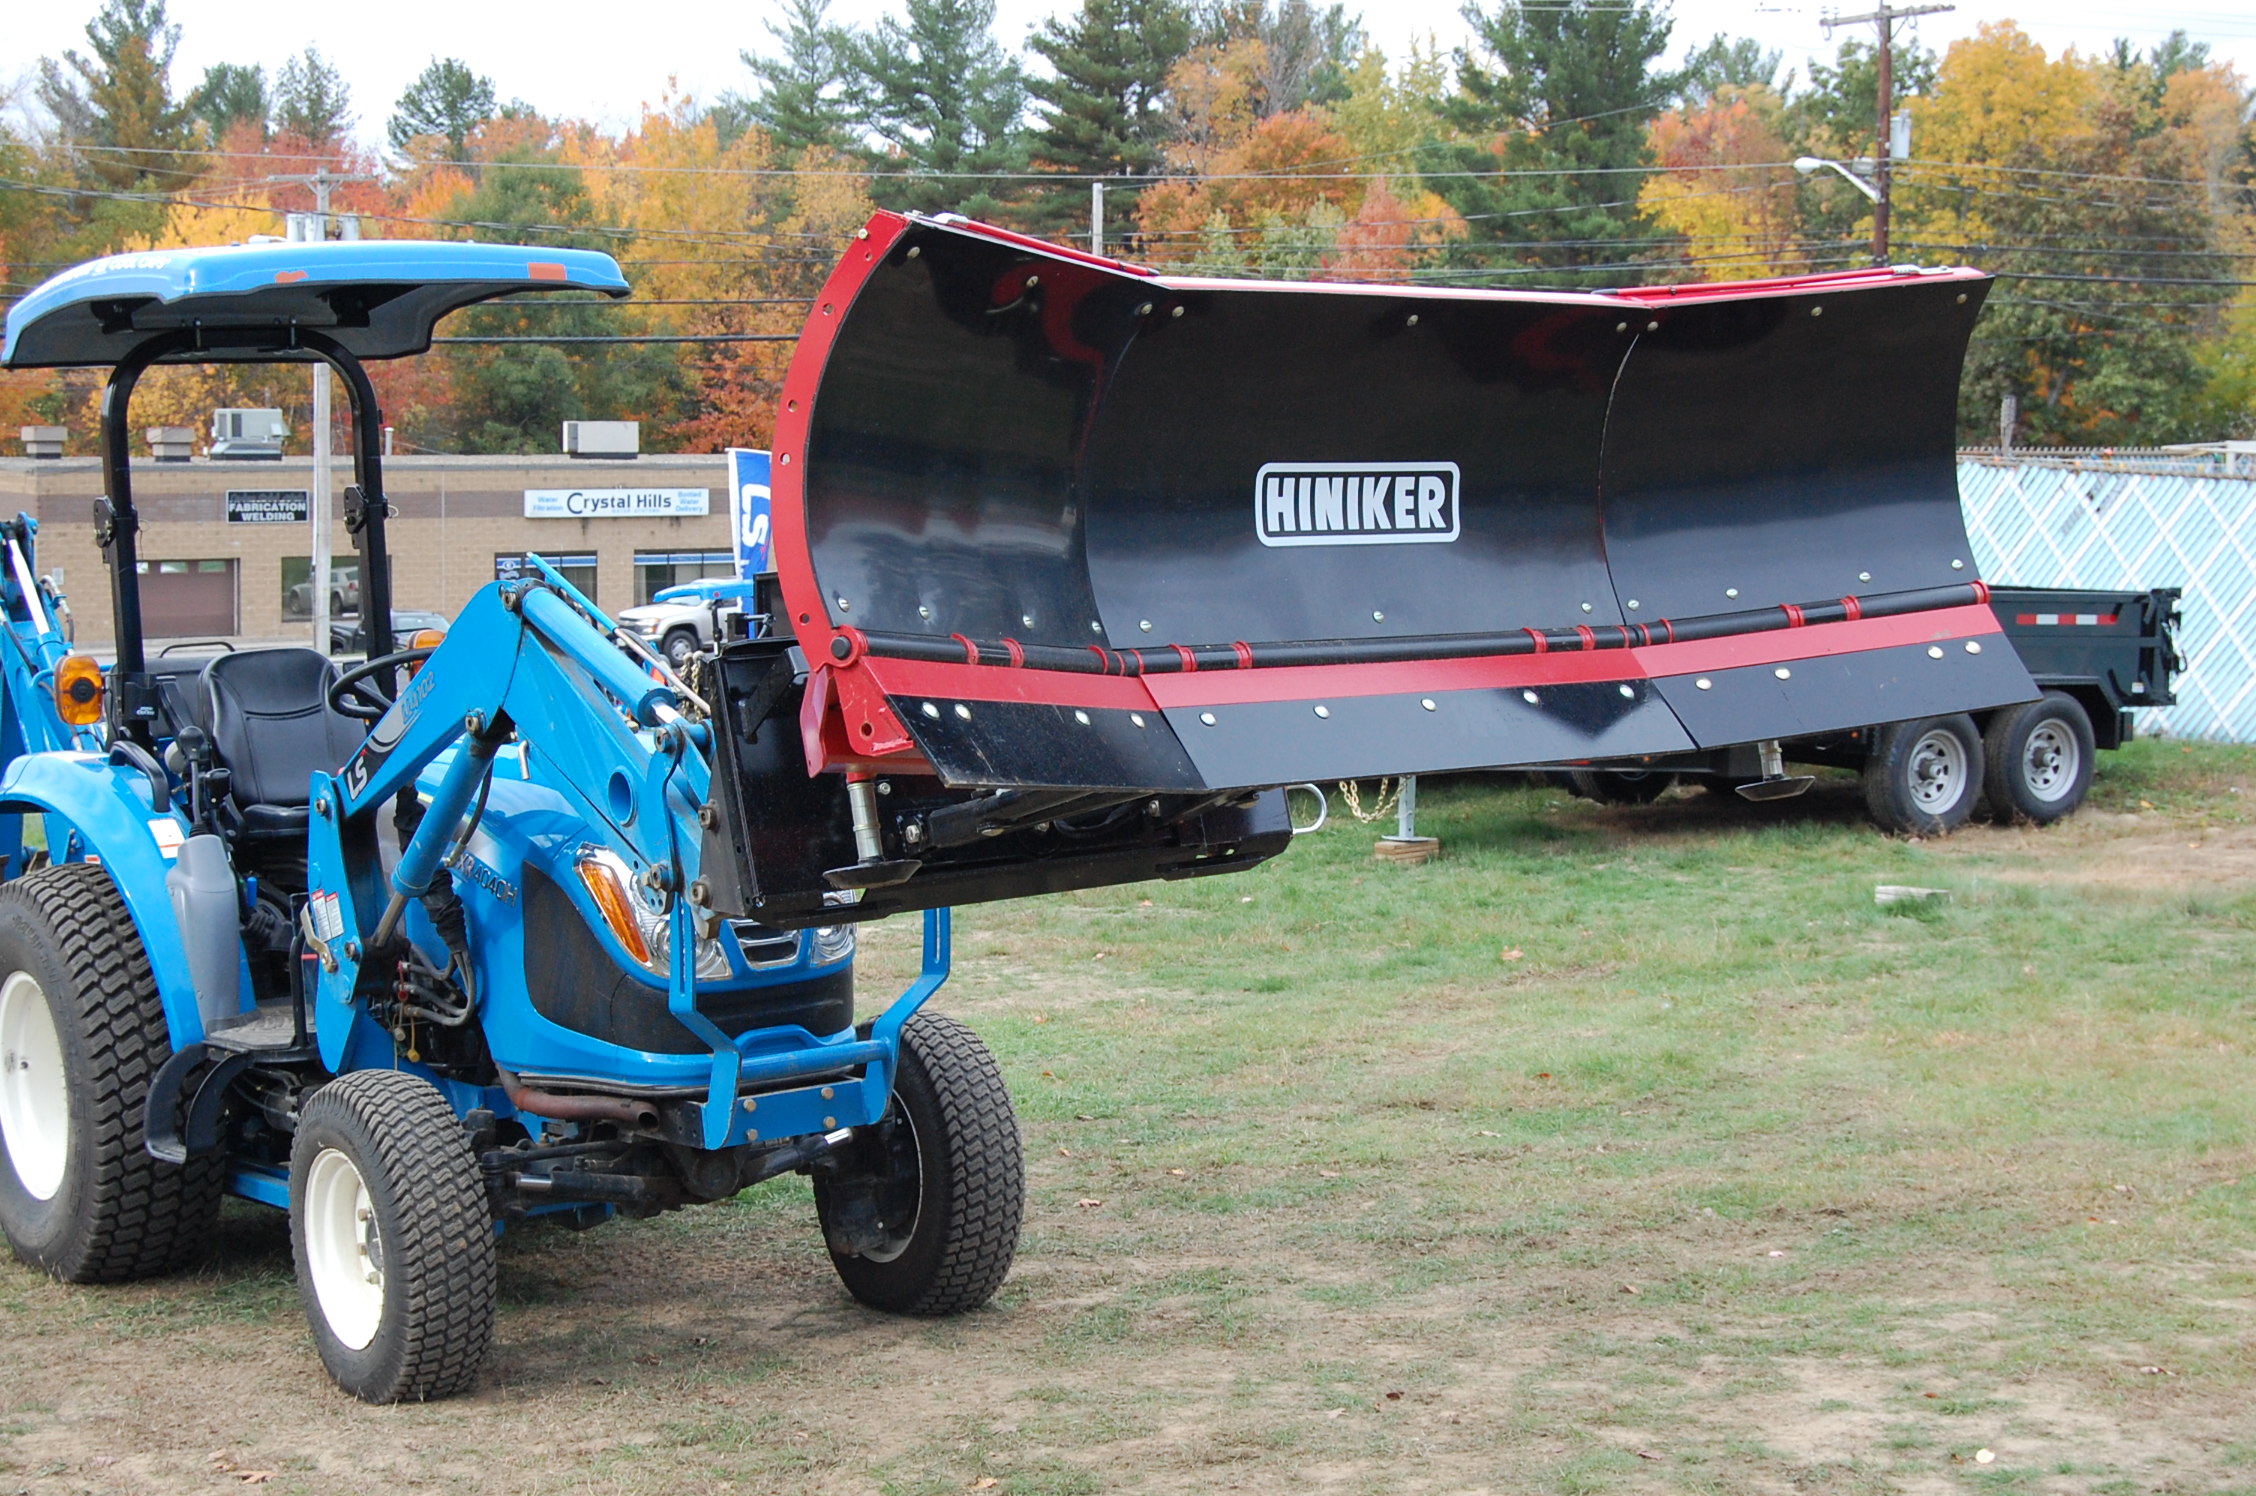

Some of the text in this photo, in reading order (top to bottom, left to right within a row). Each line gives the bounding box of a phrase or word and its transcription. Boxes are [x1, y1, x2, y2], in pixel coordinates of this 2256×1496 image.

[229, 502, 306, 512] FABRICATION
[567, 492, 671, 514] Crystal Hills
[1266, 475, 1447, 532] HINIKER
[241, 512, 295, 521] WELDING
[347, 755, 368, 801] LS
